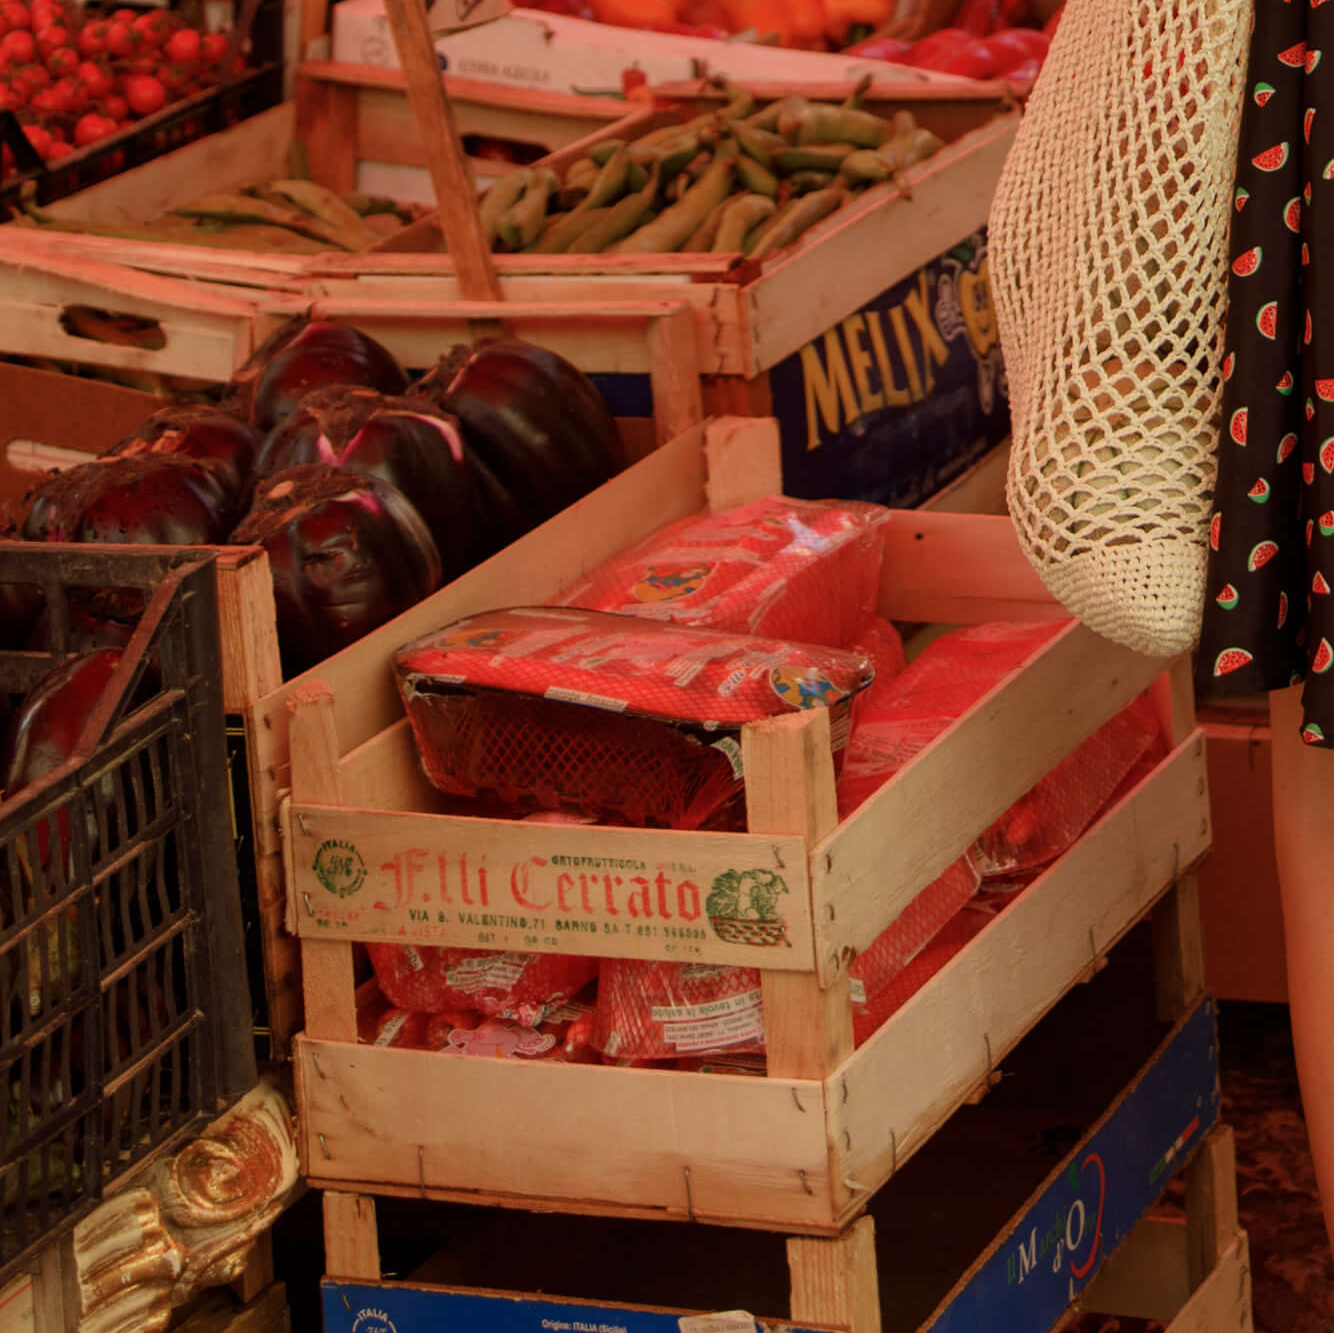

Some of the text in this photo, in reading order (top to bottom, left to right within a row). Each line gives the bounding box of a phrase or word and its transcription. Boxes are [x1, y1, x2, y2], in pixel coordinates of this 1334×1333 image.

[800, 271, 949, 451] MELIX
[373, 847, 702, 922] F.lli Cerrato
[408, 908, 430, 923] VIA
[357, 1308, 388, 1323] ITALIA
